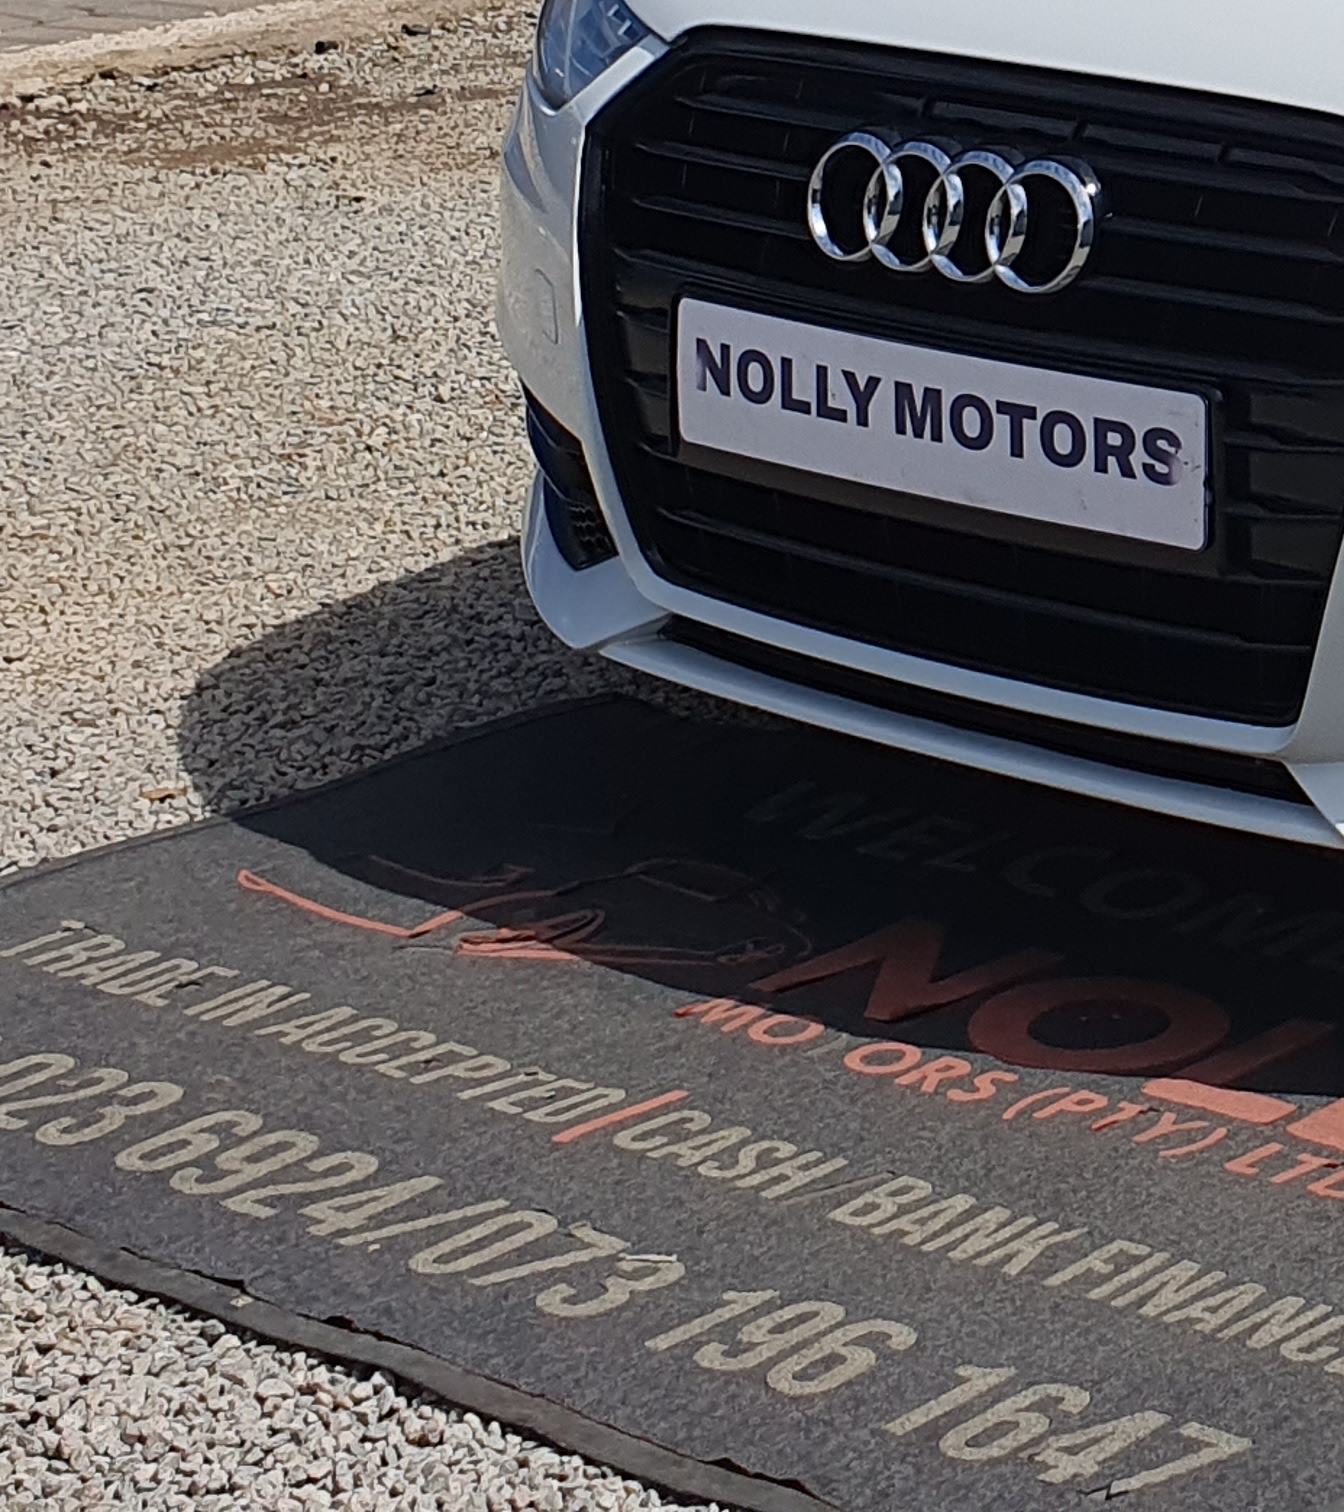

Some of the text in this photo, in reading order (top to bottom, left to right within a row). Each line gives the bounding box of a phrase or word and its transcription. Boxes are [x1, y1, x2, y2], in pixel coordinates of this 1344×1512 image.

[695, 338, 1183, 486] NOLLY MOTORS
[0, 919, 239, 1007] TRADE
[183, 979, 311, 1027] IN
[1002, 1086, 1228, 1159] (PTY)
[643, 1288, 919, 1397] 196
[881, 1363, 1254, 1494] 1647
